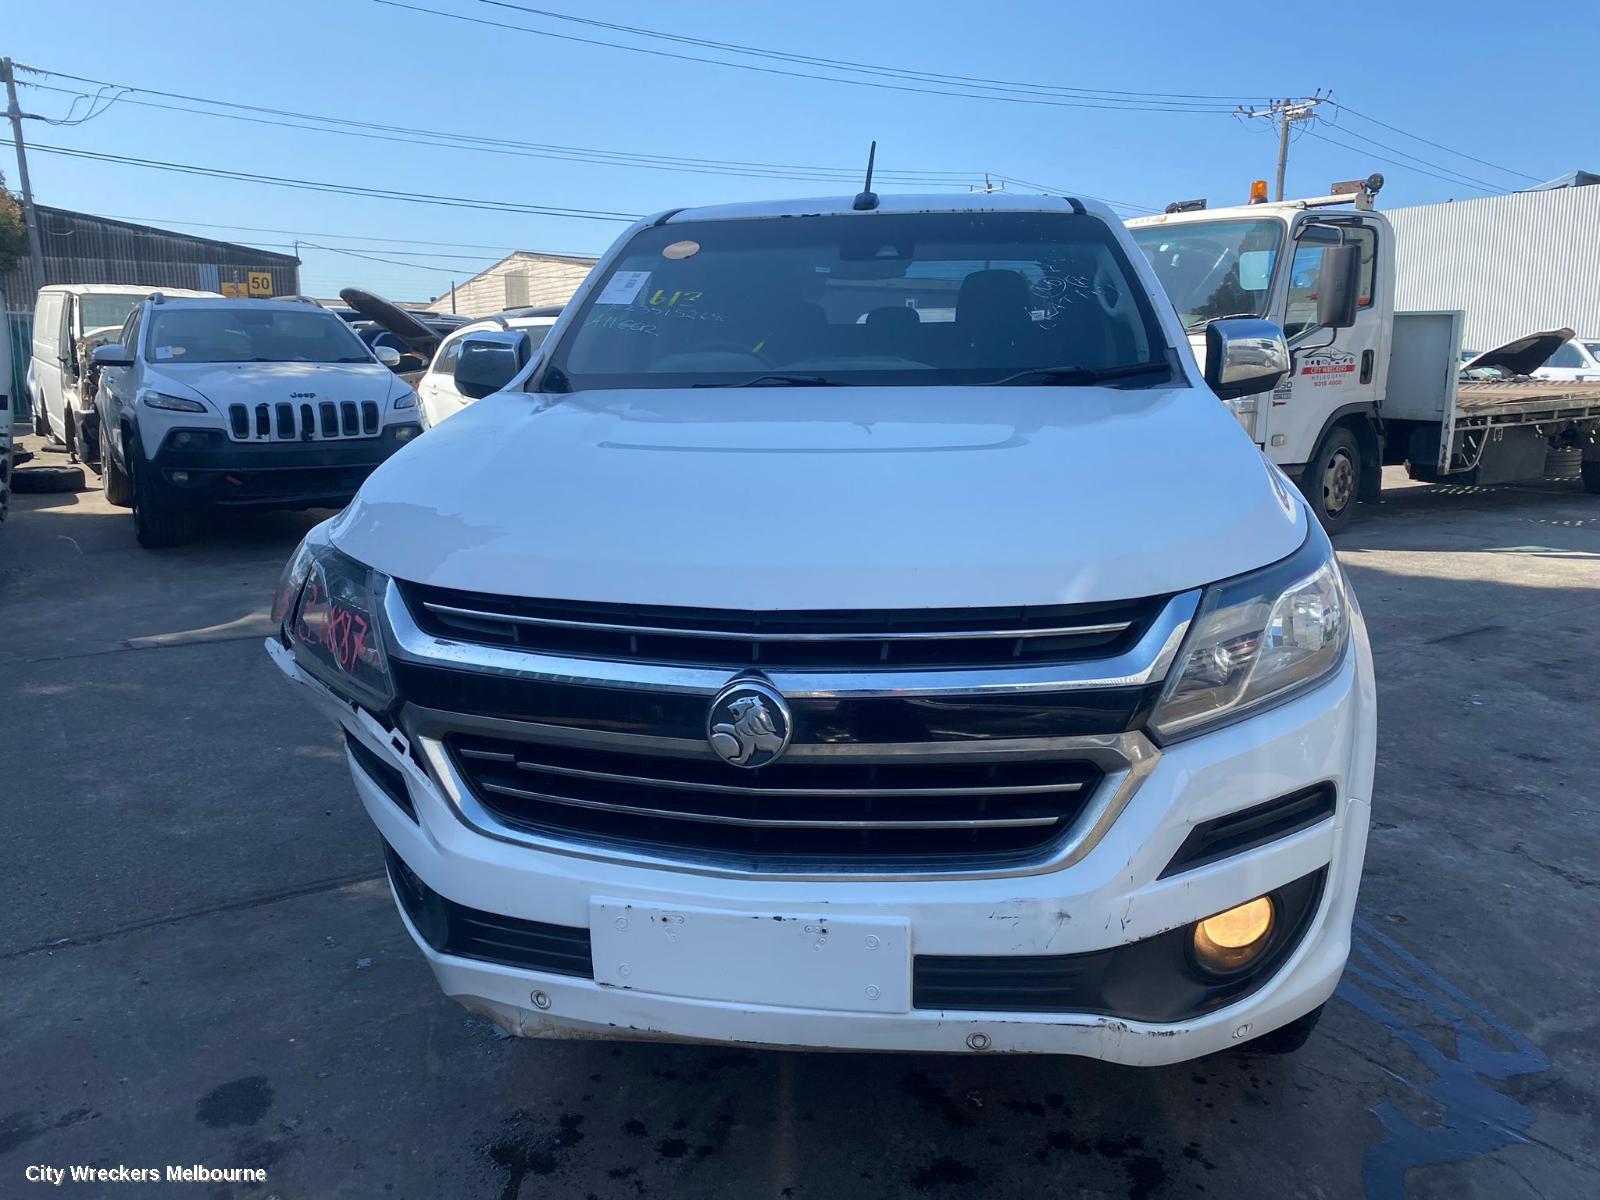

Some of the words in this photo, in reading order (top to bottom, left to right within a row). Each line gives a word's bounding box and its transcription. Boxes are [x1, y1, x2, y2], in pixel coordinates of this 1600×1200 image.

[252, 277, 270, 290] 50
[1322, 365, 1348, 373] WRECKERS
[290, 391, 316, 399] Jeep
